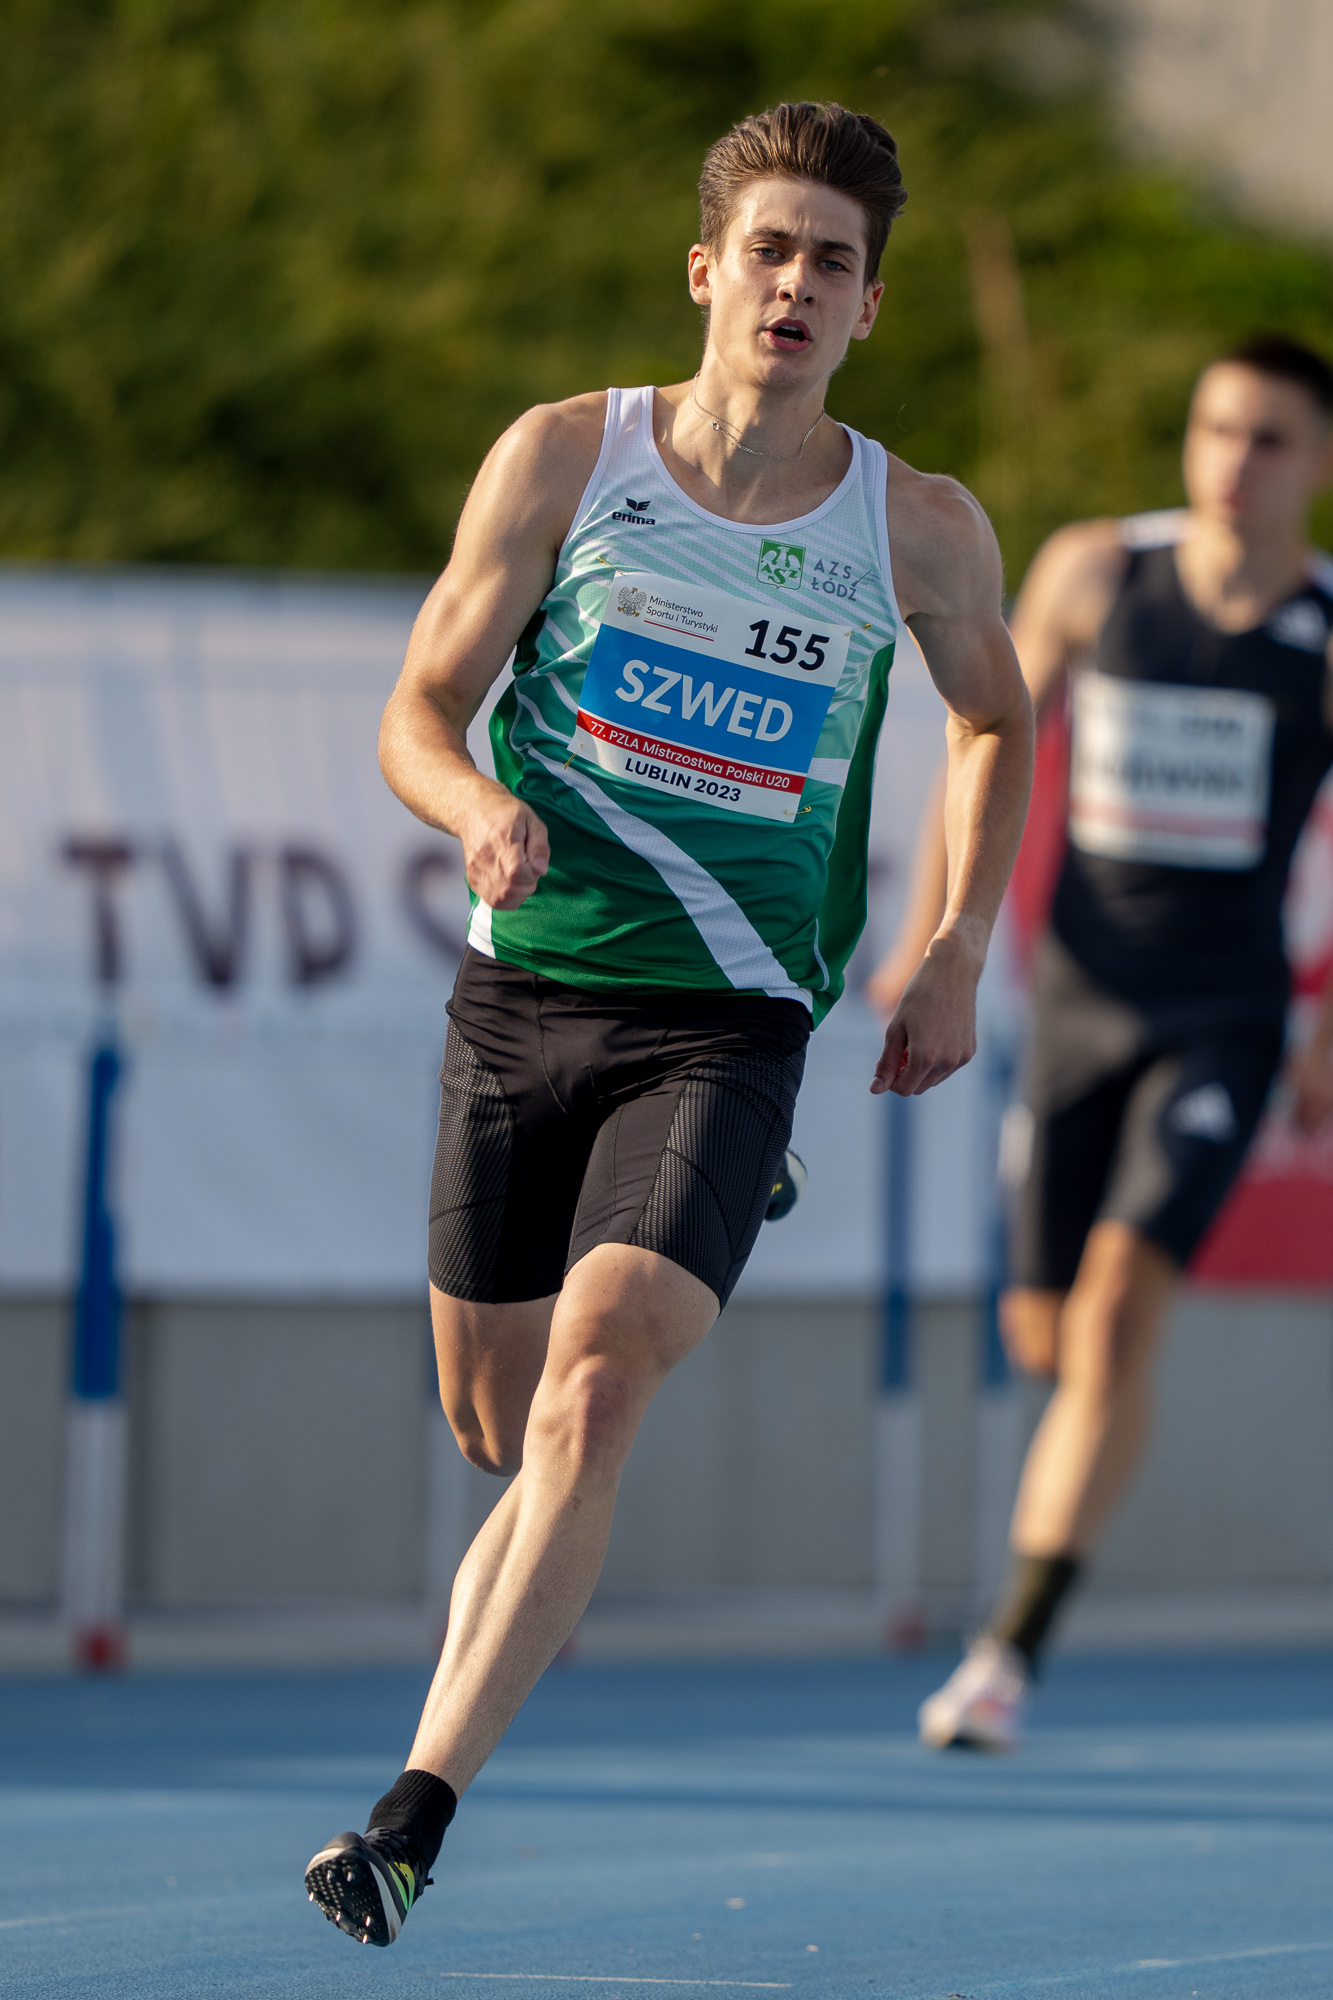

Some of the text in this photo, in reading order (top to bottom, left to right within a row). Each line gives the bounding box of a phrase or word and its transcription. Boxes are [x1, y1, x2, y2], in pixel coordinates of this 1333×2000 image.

[612, 511, 656, 526] erima
[813, 558, 852, 580] AZS
[646, 606, 675, 622] Sportu
[681, 616, 719, 633] Turystyki
[649, 595, 703, 618] Ministerstwo
[744, 619, 830, 671] 155
[615, 659, 793, 742] SZWED
[590, 720, 790, 789] 77. PZLA Mistrzostwa Polski U20
[624, 757, 742, 802] LUBLIN 2023
